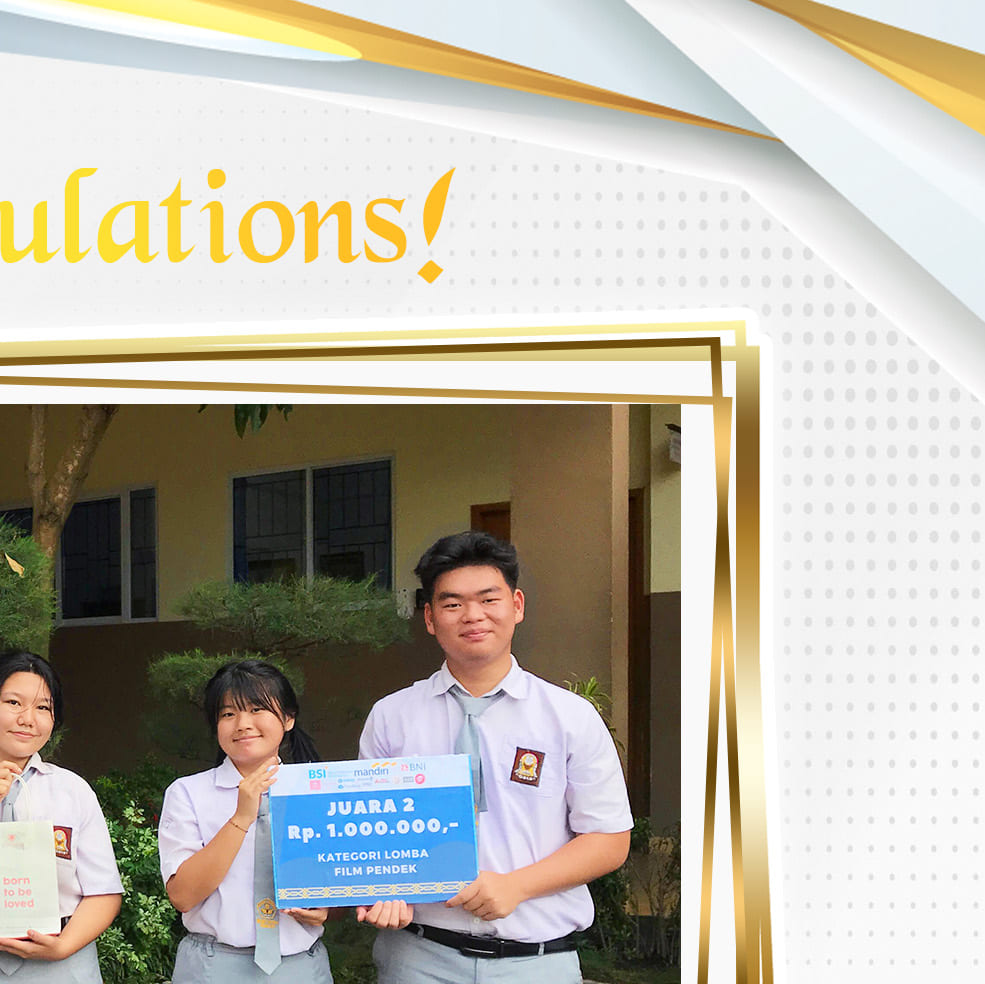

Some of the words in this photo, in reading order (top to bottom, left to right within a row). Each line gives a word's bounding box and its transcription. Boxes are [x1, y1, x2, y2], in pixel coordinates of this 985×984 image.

[409, 763, 426, 771] BNI
[308, 768, 327, 779] BSI
[327, 798, 397, 816] JUARA
[403, 797, 415, 812] 2
[287, 825, 321, 843] Rp.
[326, 818, 459, 838] 1.000.000,-
[318, 851, 381, 863] KATEGORI
[385, 849, 429, 860] LOMBA
[334, 866, 363, 876] FILM
[366, 864, 417, 875] PENDEK
[3, 876, 30, 885] born
[4, 887, 15, 896] to
[18, 887, 32, 896] be
[4, 898, 34, 908] loved
